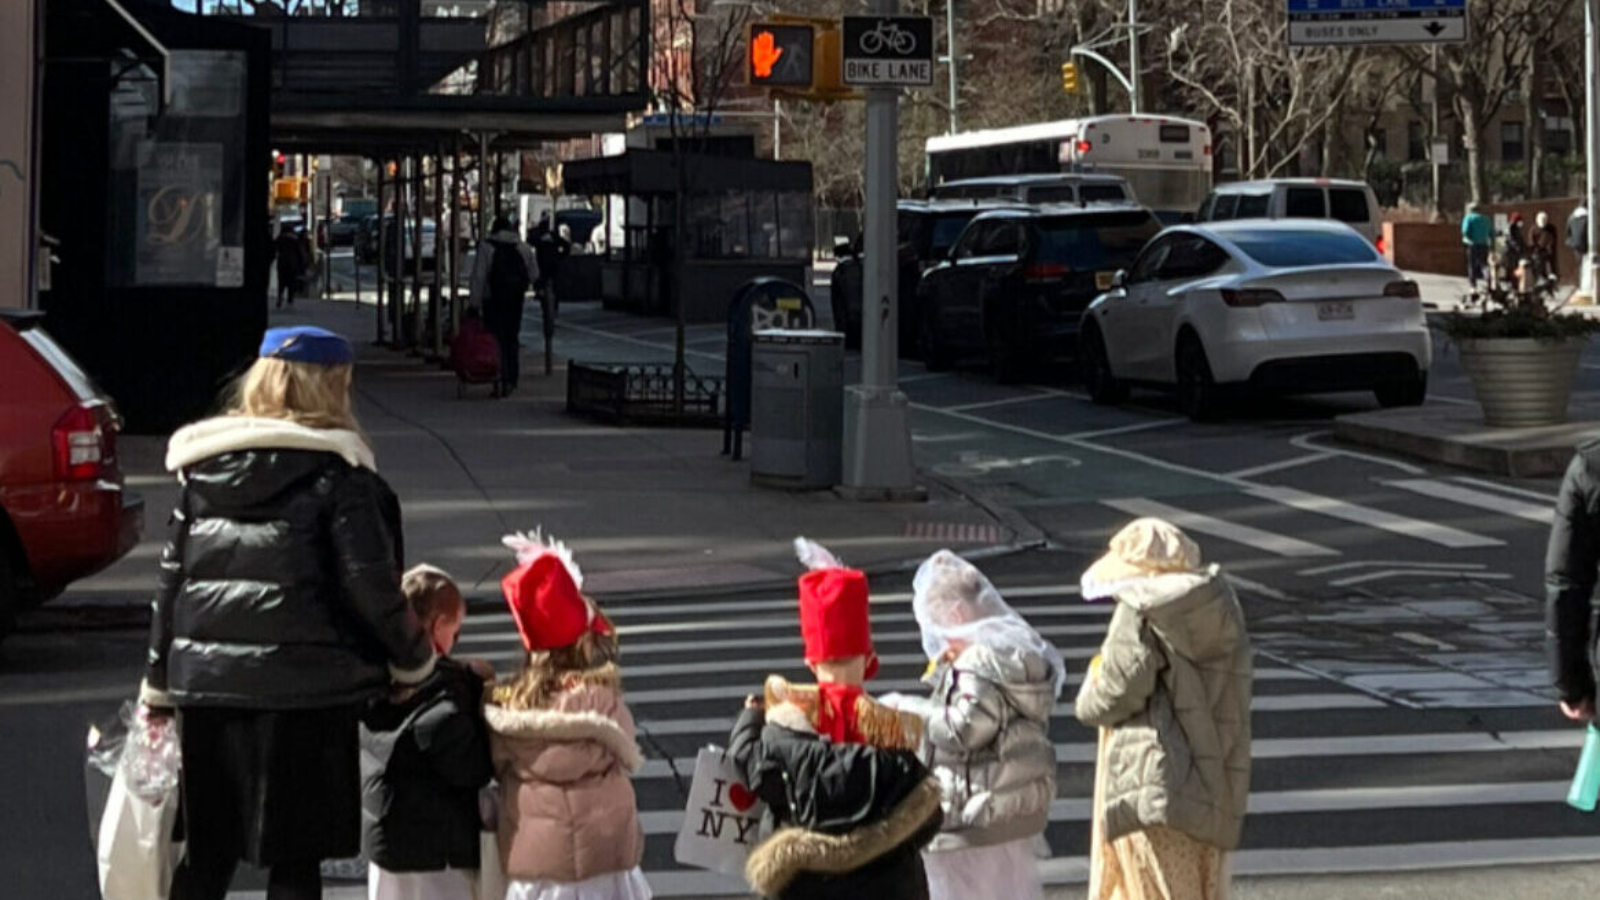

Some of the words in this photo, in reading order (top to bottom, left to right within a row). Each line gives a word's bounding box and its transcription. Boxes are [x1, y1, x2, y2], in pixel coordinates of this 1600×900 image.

[1305, 26, 1343, 38] BUSES
[1348, 25, 1378, 37] ONLY
[847, 62, 880, 80] BIKE
[888, 62, 928, 79] LANE
[709, 778, 726, 807] I
[696, 807, 760, 844] NY
